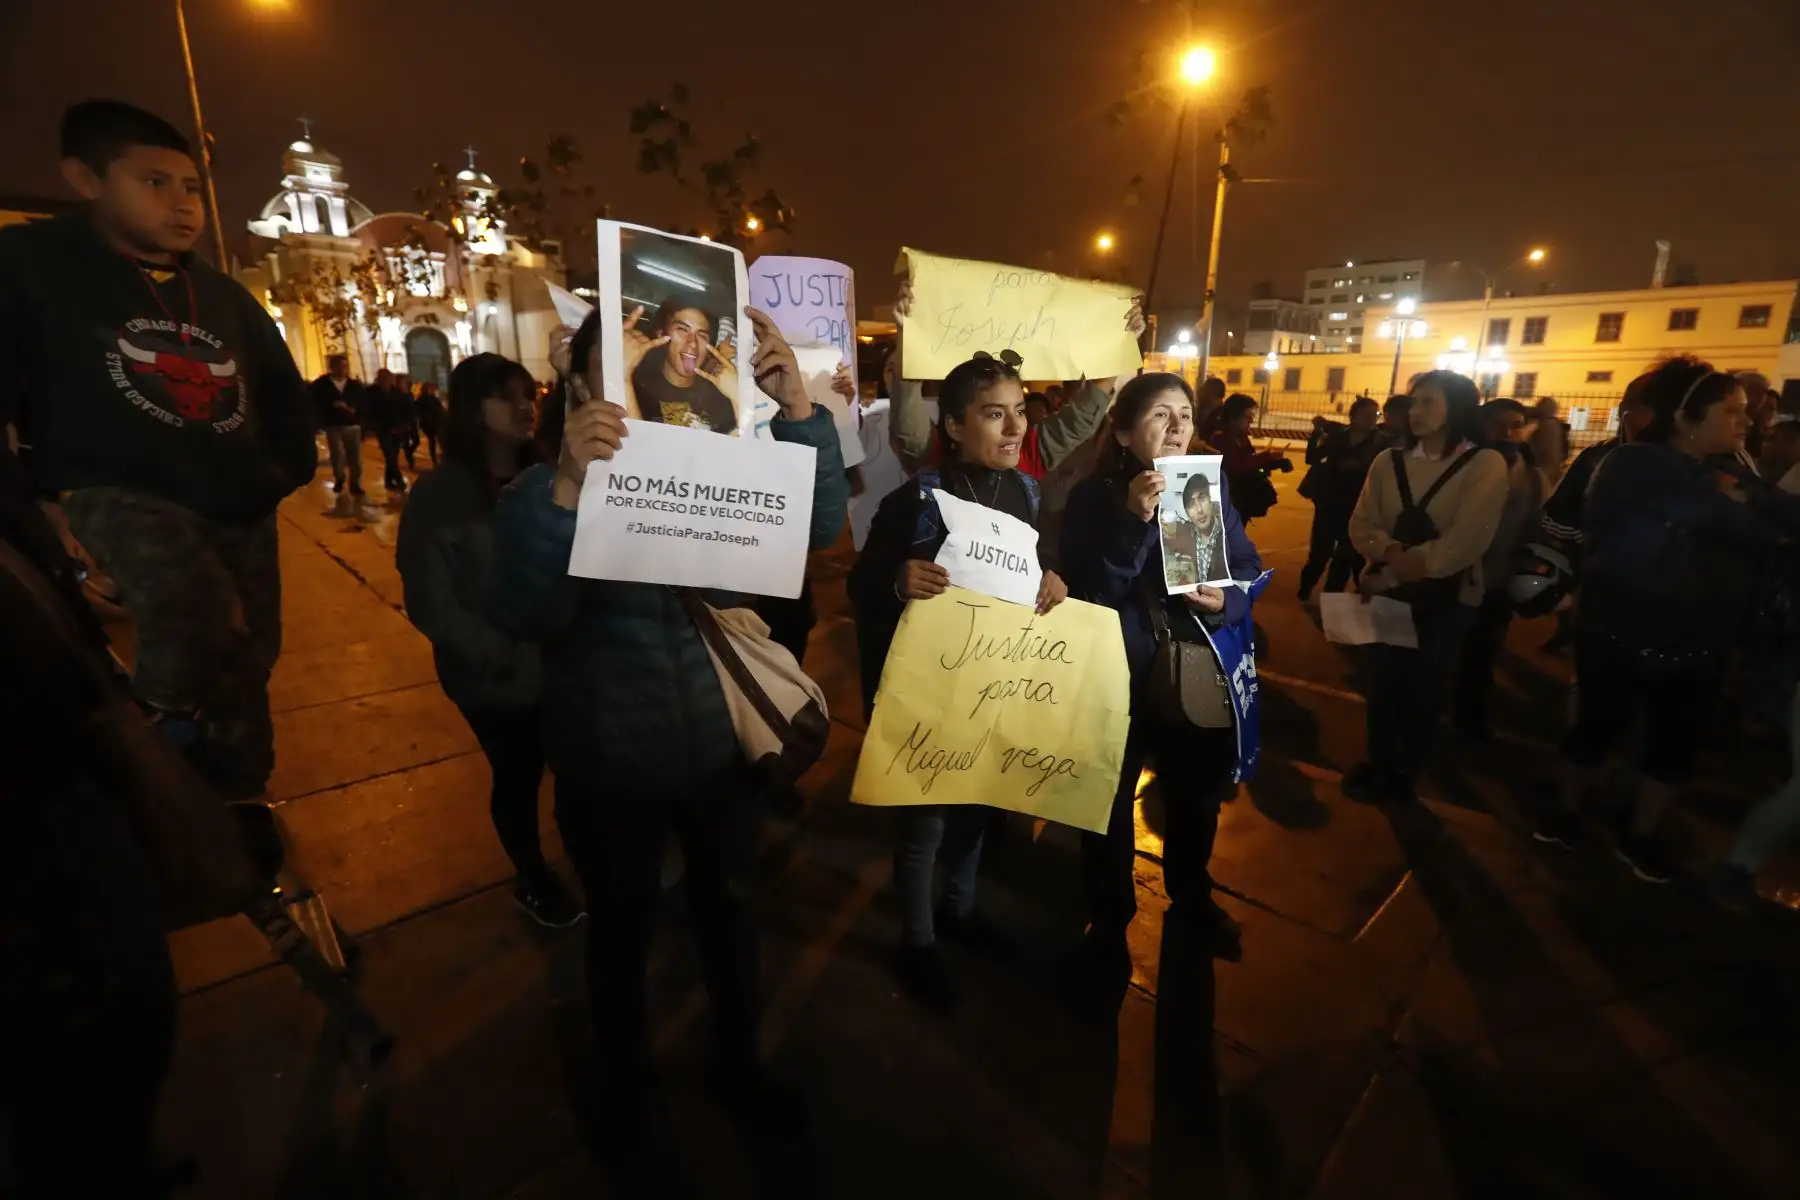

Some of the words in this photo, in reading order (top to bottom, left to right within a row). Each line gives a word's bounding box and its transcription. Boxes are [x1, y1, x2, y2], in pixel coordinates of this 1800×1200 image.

[987, 270, 1053, 306] para
[931, 303, 1057, 354] Joseph
[607, 473, 642, 493] NO
[645, 476, 690, 498] MÁS
[693, 483, 787, 511] MUERTES
[605, 495, 633, 508] POR
[635, 498, 688, 515] EXCESO
[689, 504, 708, 517] DE
[709, 506, 785, 527] VELOCIDAD
[991, 521, 1001, 536] #
[625, 521, 760, 547] #JusticiaParaJoseph
[965, 540, 1029, 576] JUSTICIA
[940, 600, 1074, 671] Justicia
[969, 676, 1059, 720] para
[885, 721, 991, 795] Miguel
